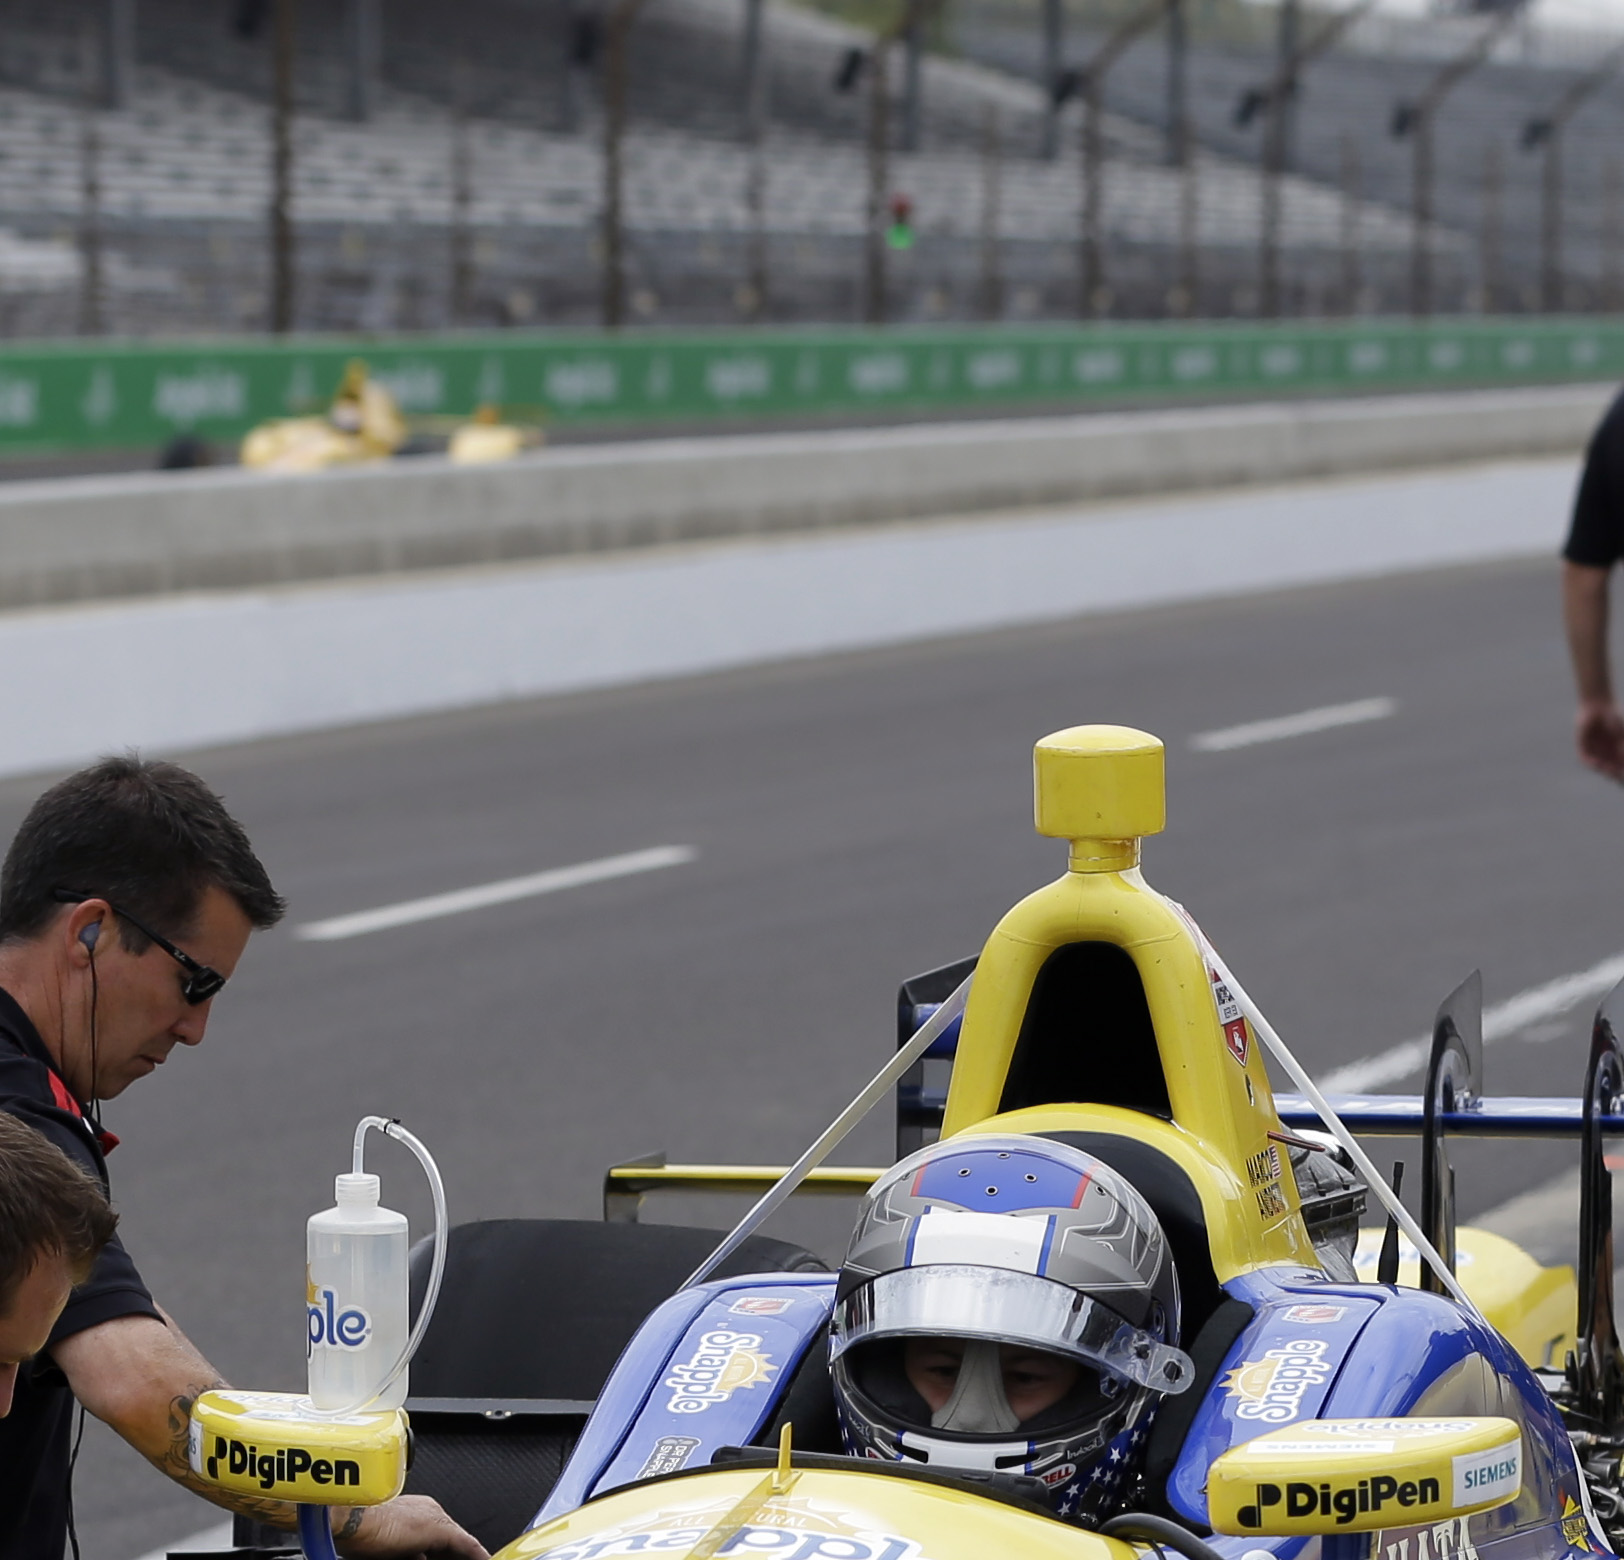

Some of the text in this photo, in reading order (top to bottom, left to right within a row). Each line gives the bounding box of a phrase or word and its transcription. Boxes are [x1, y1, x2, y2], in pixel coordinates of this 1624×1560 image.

[667, 1331, 762, 1413] Snapple
[1237, 1340, 1331, 1422] Snapple
[230, 1440, 359, 1489] DigiPen
[1041, 1466, 1072, 1485] BELL
[1464, 1458, 1517, 1489] SIEMENS
[670, 1517, 705, 1527] ALL
[1287, 1476, 1439, 1525] DigiPen
